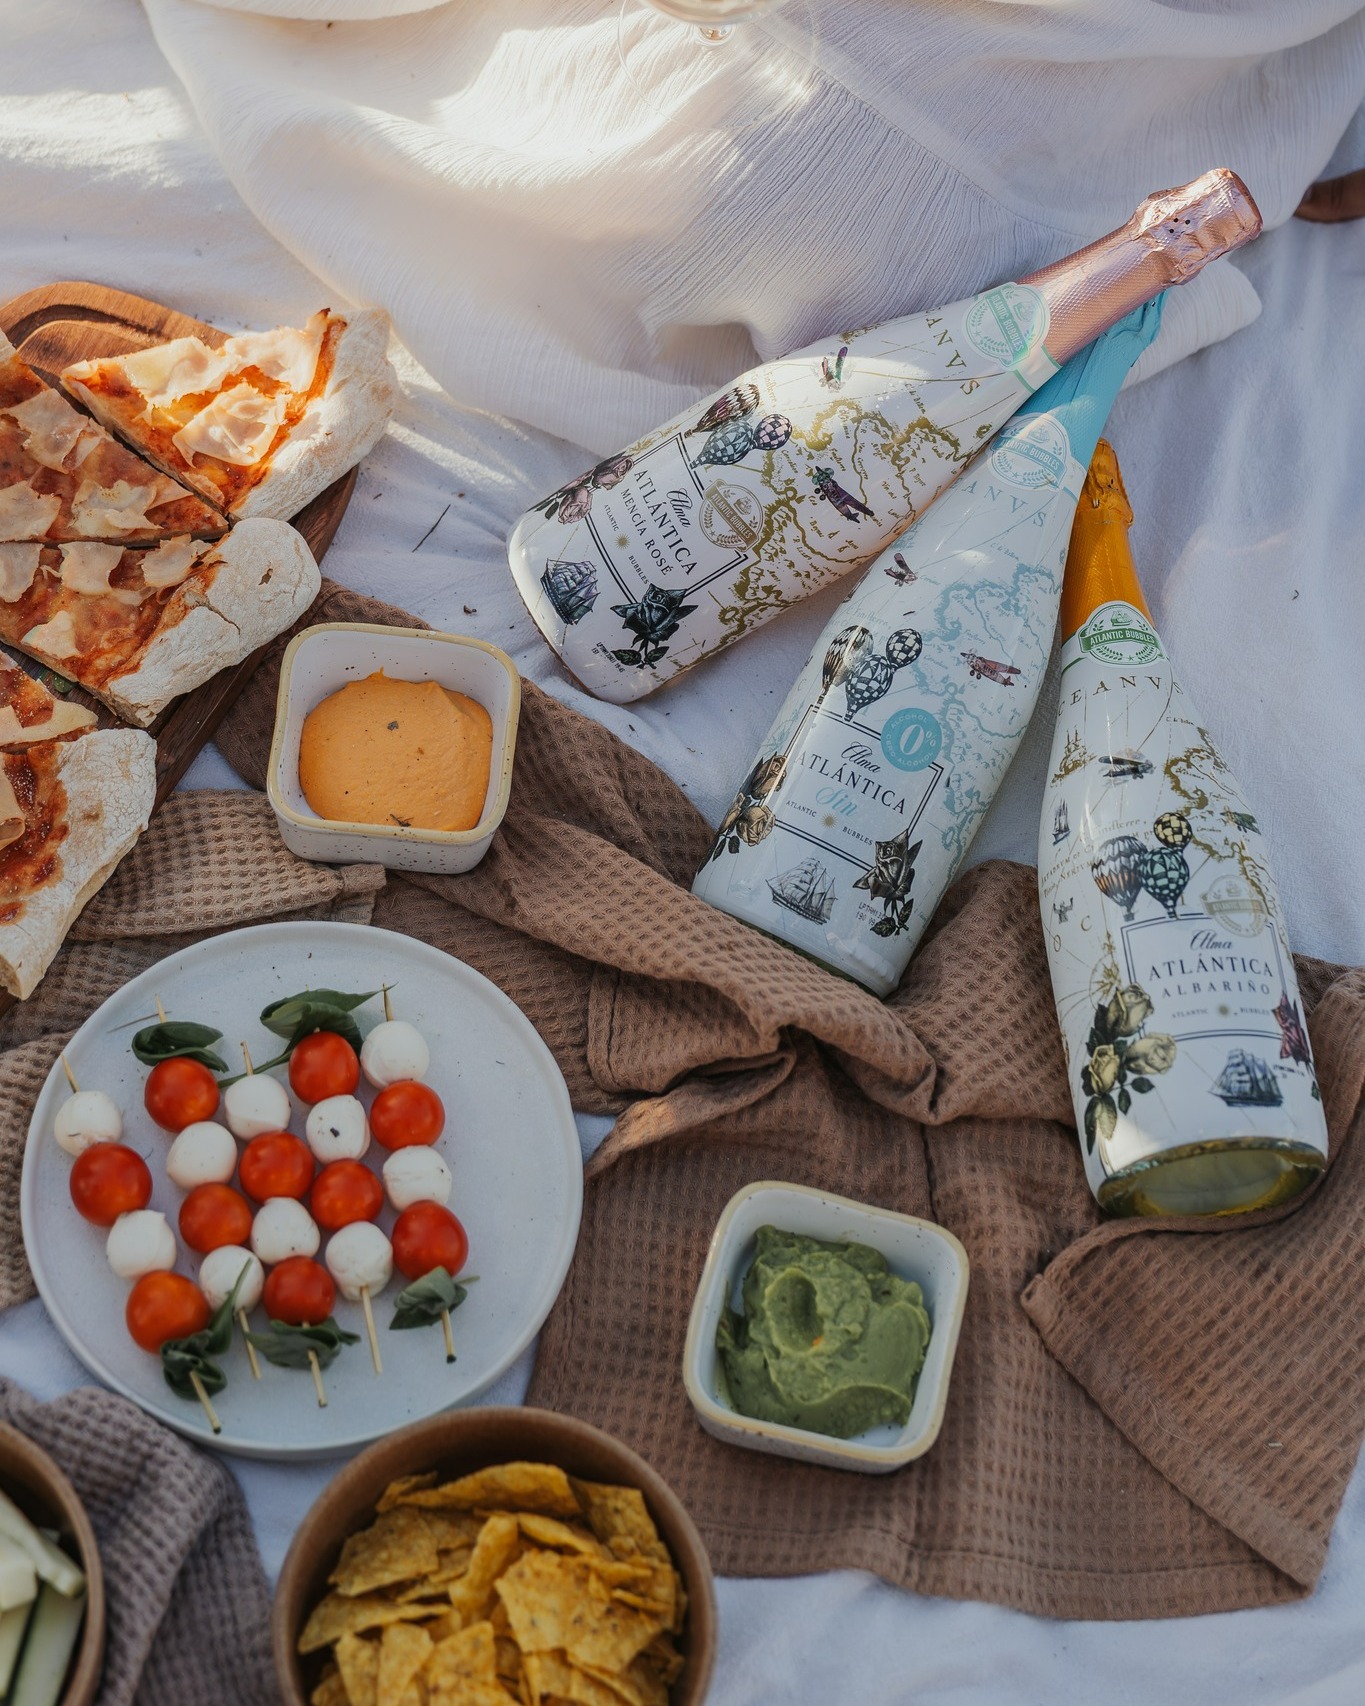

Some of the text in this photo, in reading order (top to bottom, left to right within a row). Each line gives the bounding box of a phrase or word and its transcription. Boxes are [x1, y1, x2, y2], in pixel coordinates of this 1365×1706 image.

[1003, 318, 1024, 352] BUBBLES
[1030, 446, 1060, 470] BUBBLES
[634, 470, 698, 576] ATLÁNTICA
[666, 488, 693, 528] Alma
[710, 494, 752, 539] ATLANTIC BUBBLES
[604, 504, 650, 585] ATLANTIC BUBBLES
[620, 488, 674, 576] MENCÍA ROSÉ
[1090, 630, 1155, 646] ATLANTIC BUBBLES
[891, 714, 928, 730] ALCOHOL
[840, 742, 882, 774] Alma
[897, 752, 934, 766] ALCOHOL
[794, 751, 906, 815] ATLÁNTICA
[816, 786, 858, 818] Sin
[786, 800, 874, 846] ATLANTIC BUBBLES
[1190, 930, 1232, 950] Alma
[1149, 953, 1273, 982] ATLÁNTICA
[1162, 980, 1270, 999] ALBARIÑO
[1172, 1008, 1208, 1018] ATLANTIC
